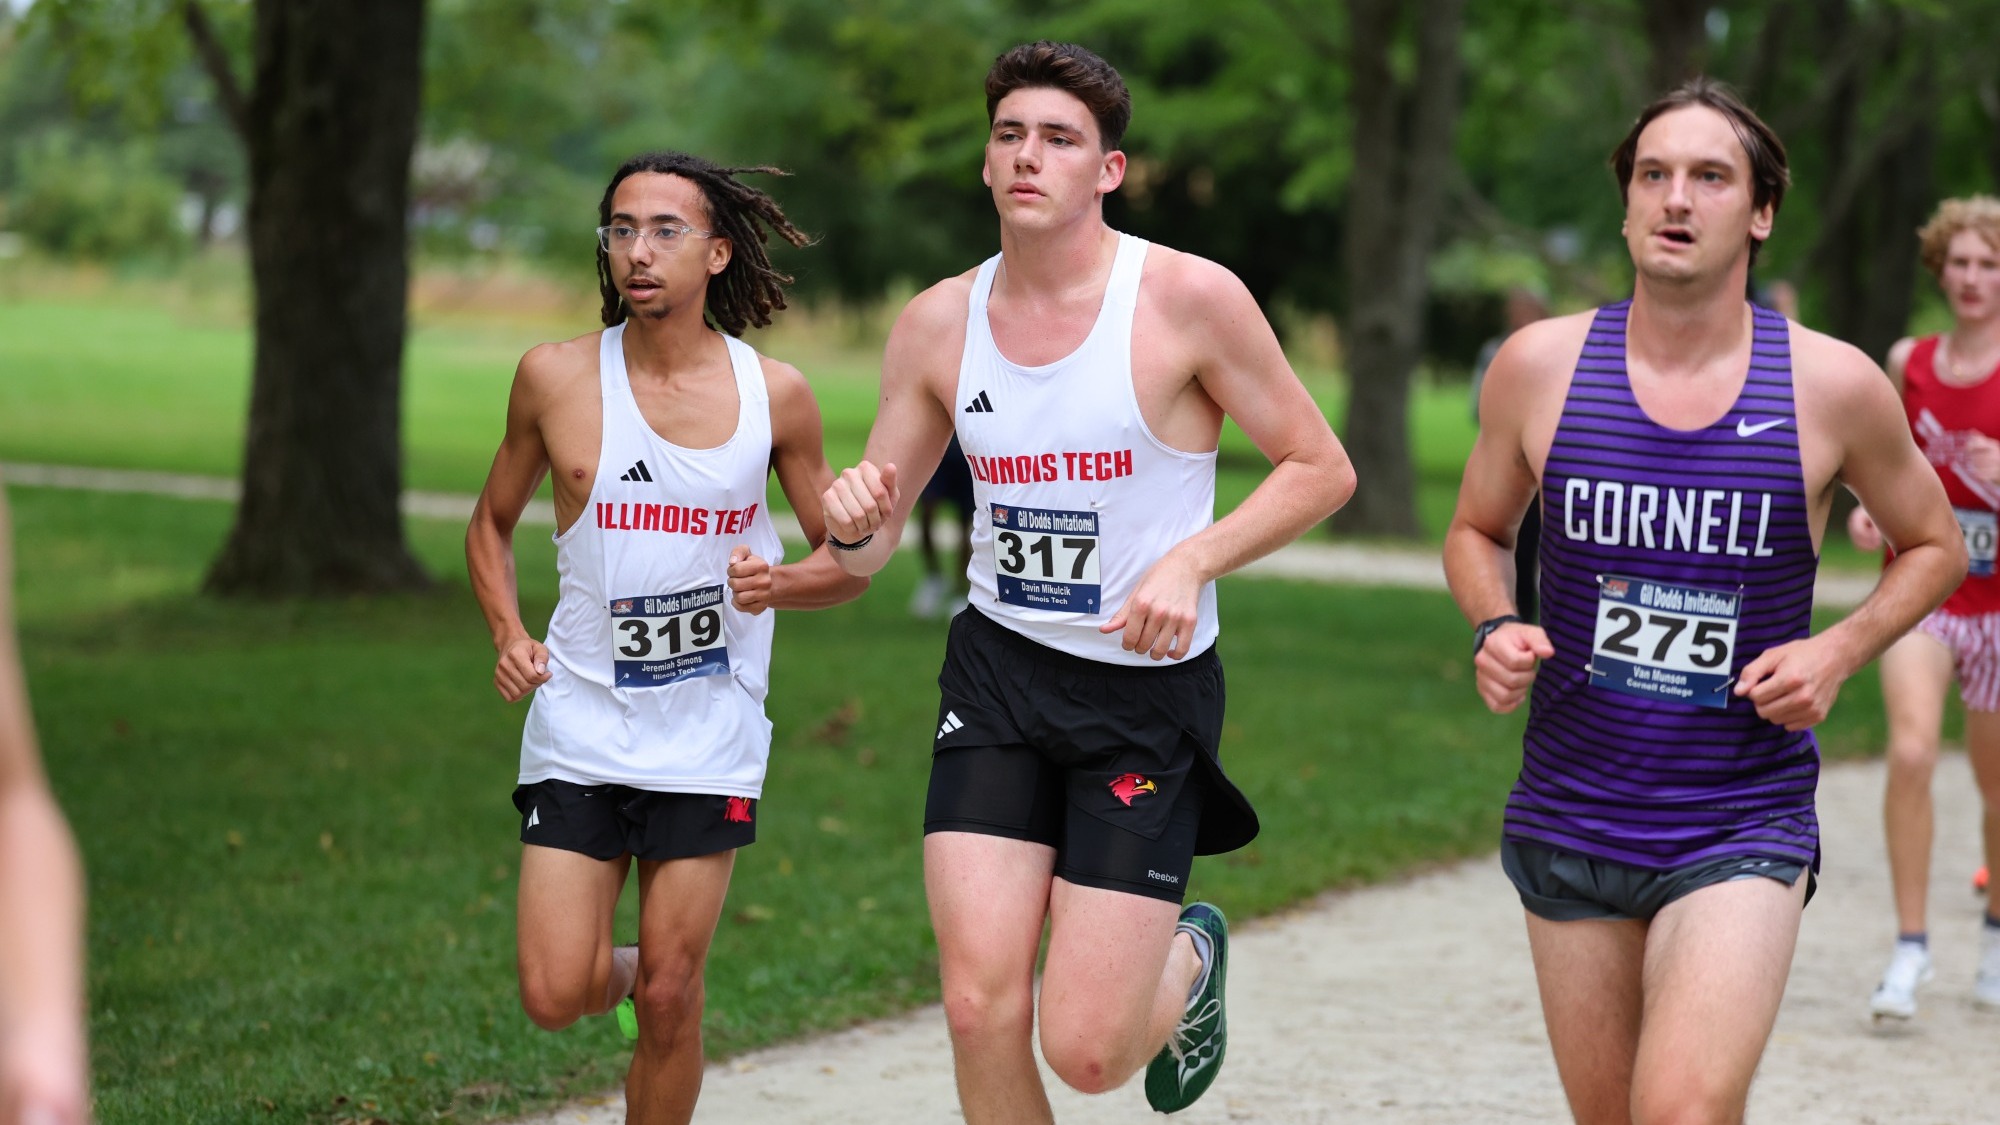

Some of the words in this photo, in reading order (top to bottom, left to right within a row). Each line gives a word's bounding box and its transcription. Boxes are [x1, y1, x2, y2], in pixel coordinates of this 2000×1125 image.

[1062, 449, 1133, 481] TECH
[596, 502, 709, 536] ILLINOIS
[1017, 510, 1028, 528] Gil
[1029, 512, 1052, 530] Dodds
[1053, 512, 1096, 532] Invitational
[1564, 478, 1774, 557] CORNELL
[997, 531, 1096, 580] 317
[644, 598, 655, 614] Gil
[656, 597, 680, 613] Dodds
[680, 587, 721, 610] Invitational
[1021, 582, 1040, 593] Davin
[1041, 583, 1071, 596] Mikulcik
[1026, 594, 1050, 603] Illinois
[1050, 596, 1068, 605] Tech
[1639, 583, 1654, 606] Gil
[1653, 585, 1684, 611] Dodds
[1683, 589, 1737, 616] Invitational
[618, 608, 721, 658] 319
[1601, 606, 1730, 669] 275
[641, 662, 675, 673] Jeremiah
[676, 655, 703, 667] Simons
[652, 669, 676, 680] Illinois
[677, 667, 696, 676] Tech
[1633, 666, 1650, 679] Van
[1651, 669, 1687, 685] Munson
[1626, 678, 1658, 692] Cornell
[1659, 683, 1694, 698] College
[1147, 869, 1179, 884] Reebok
